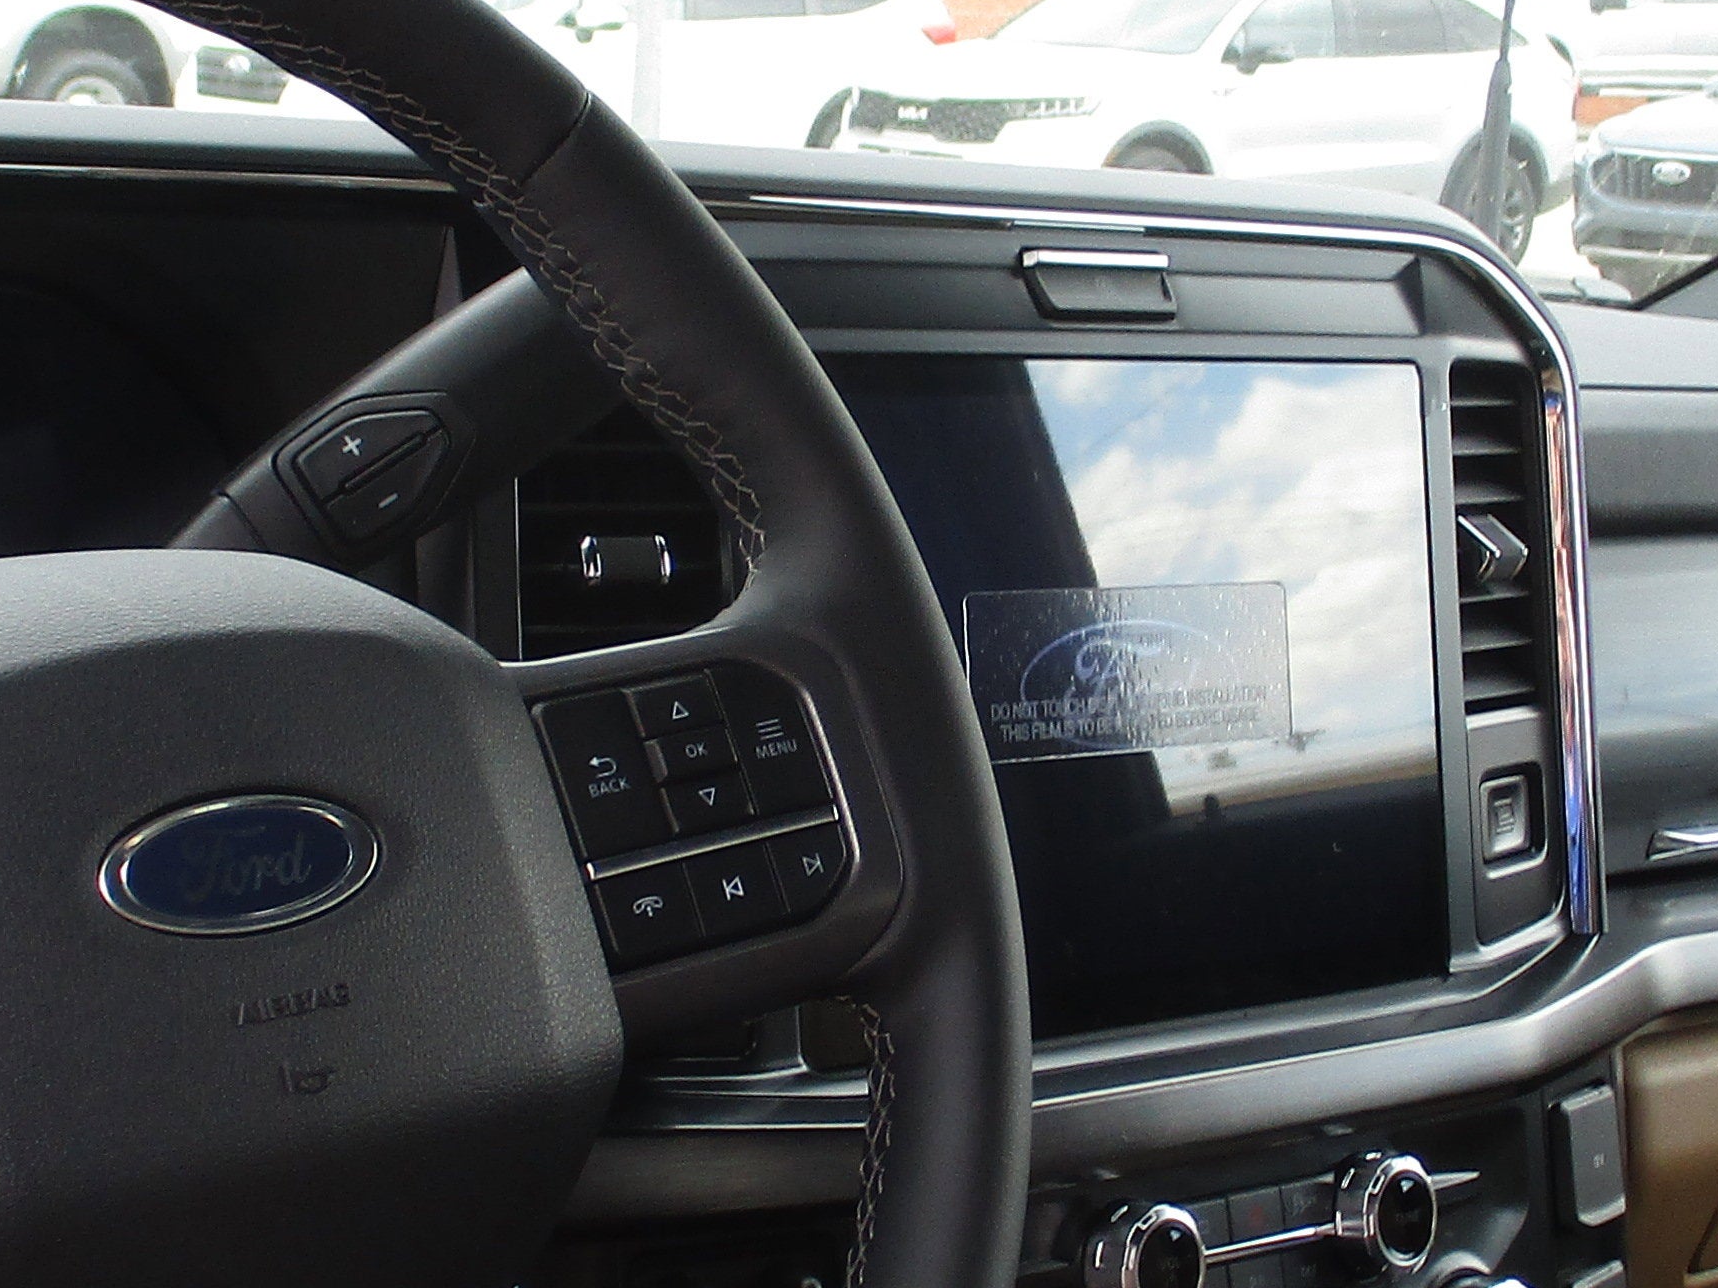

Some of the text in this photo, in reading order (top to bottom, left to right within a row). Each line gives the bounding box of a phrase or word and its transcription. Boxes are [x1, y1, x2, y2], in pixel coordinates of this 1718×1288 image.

[991, 701, 1011, 723] DO
[1013, 699, 1039, 721] NOT
[685, 741, 709, 759] OK
[755, 738, 799, 760] MENU
[588, 777, 632, 799] BACK
[180, 825, 315, 904] Ford
